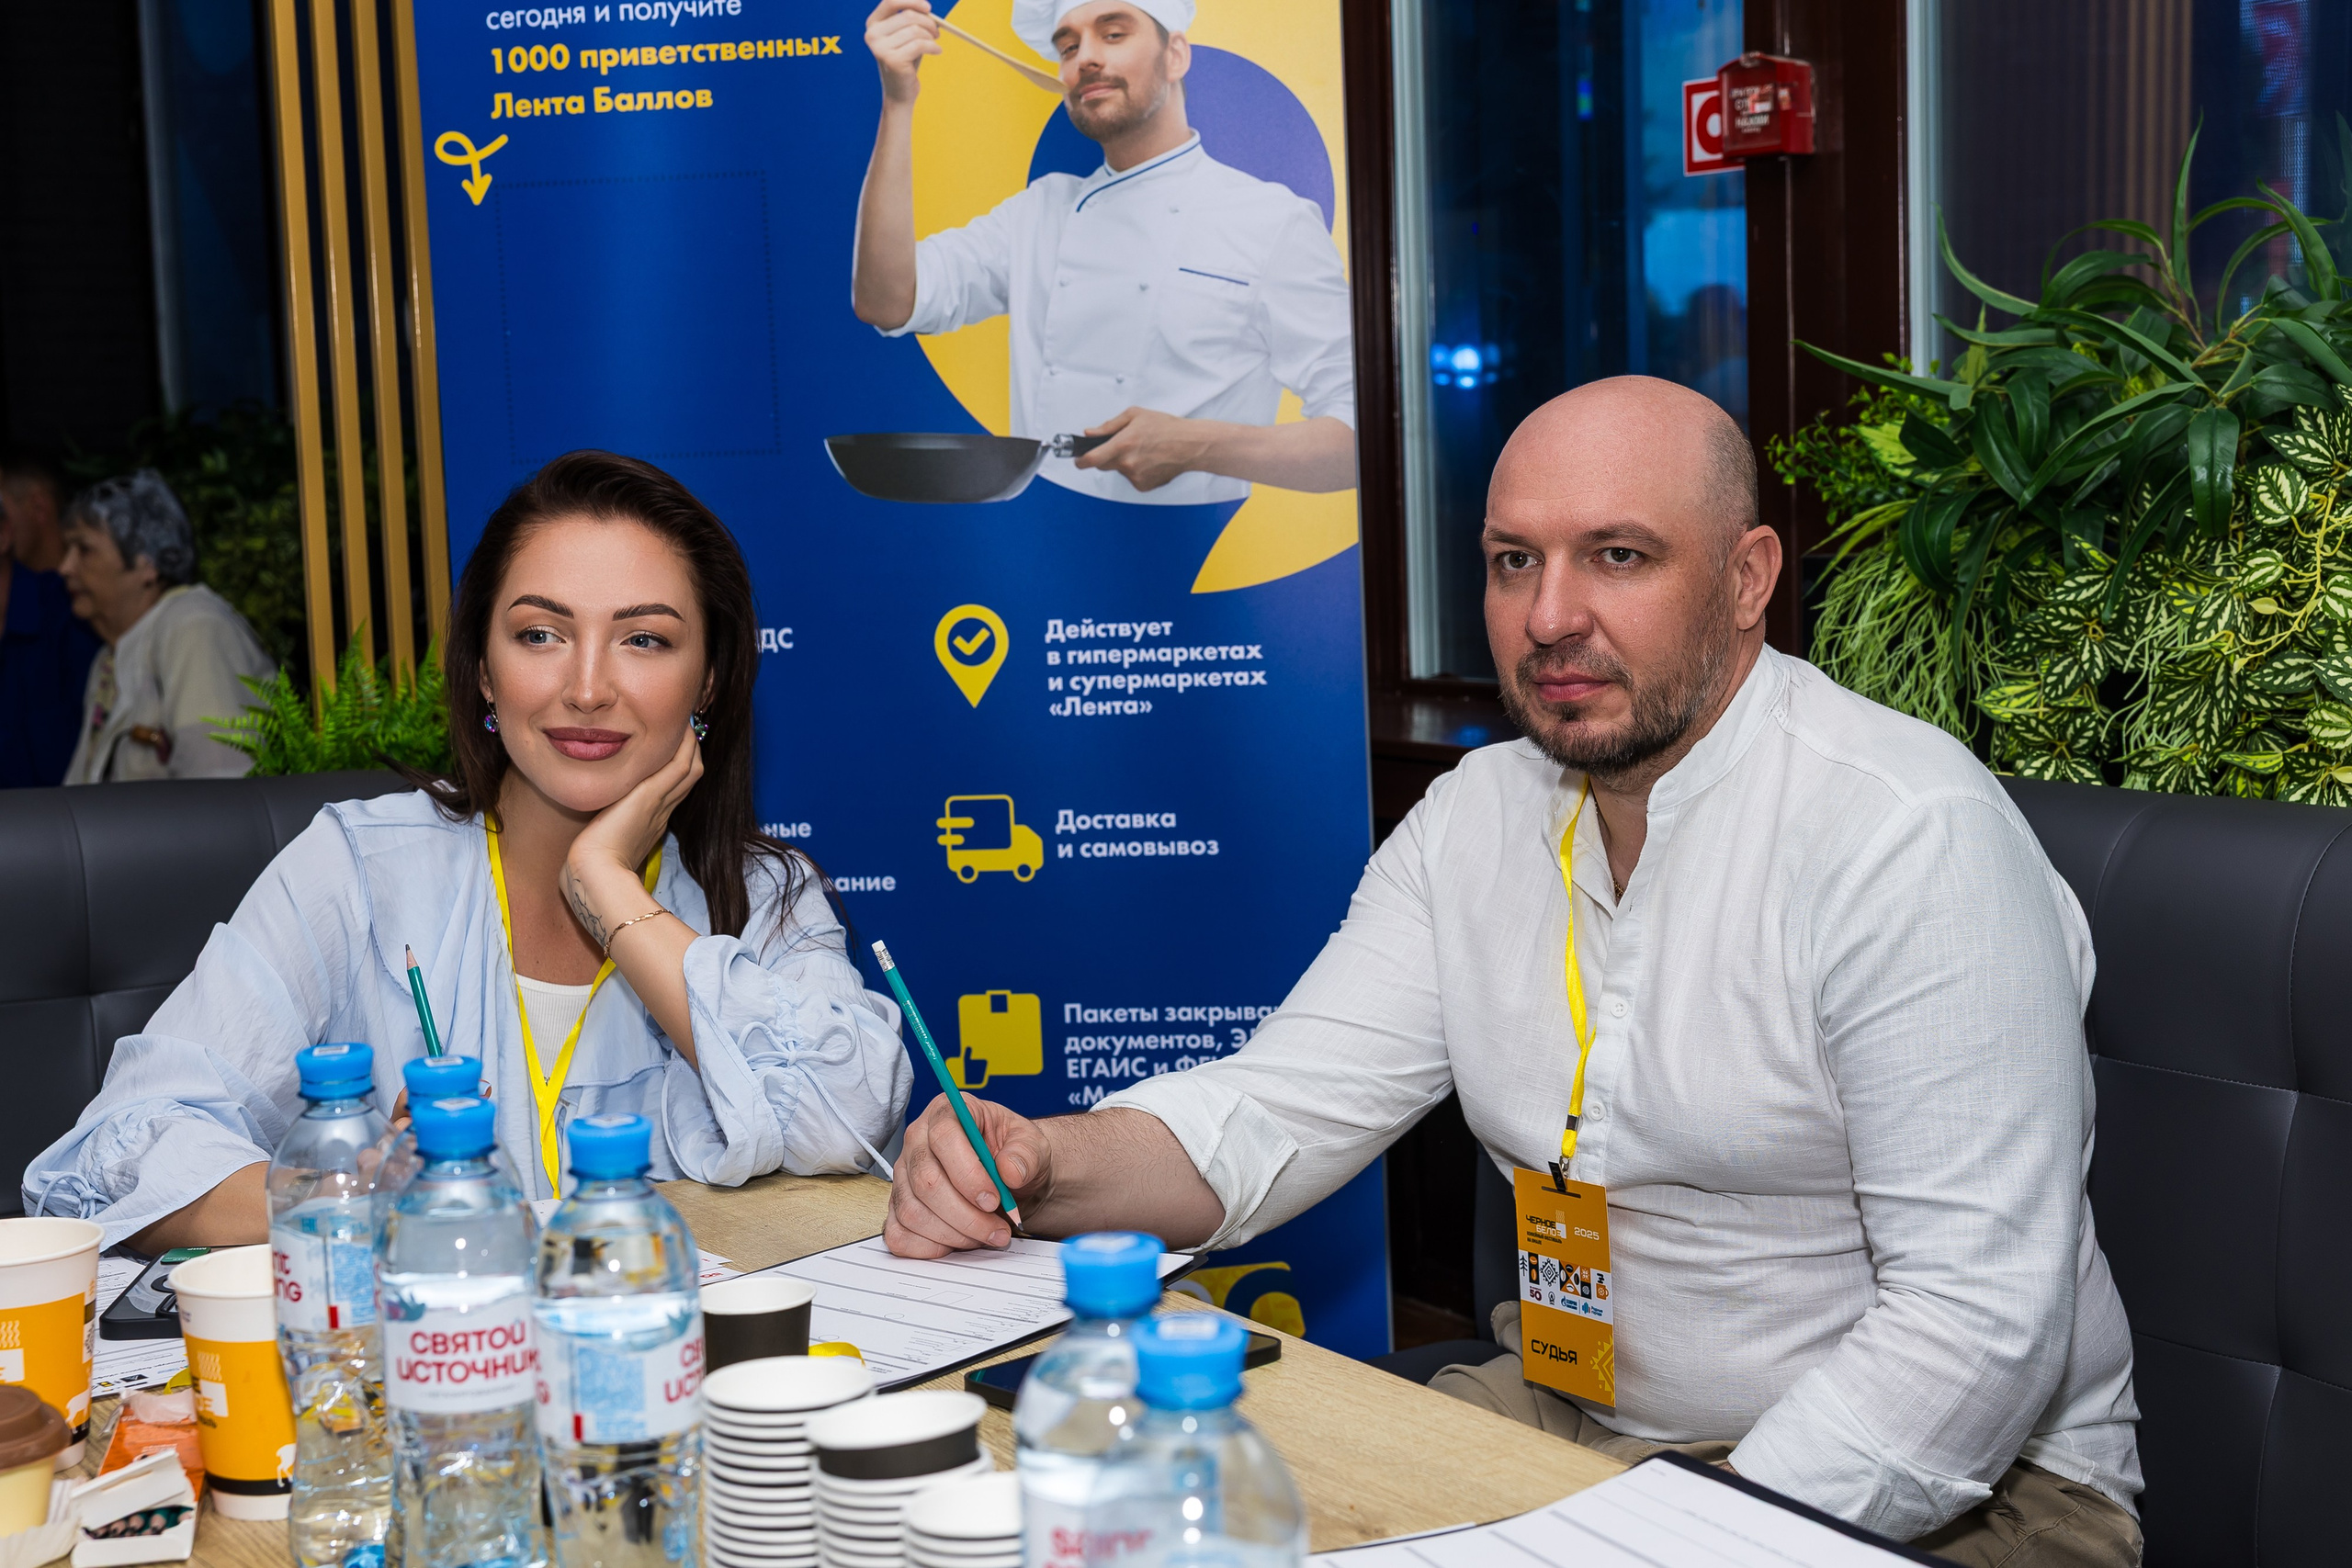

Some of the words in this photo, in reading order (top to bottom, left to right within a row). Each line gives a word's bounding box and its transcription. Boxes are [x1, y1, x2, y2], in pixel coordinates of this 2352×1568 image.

[486, 6, 586, 30] сегодня
[594, 5, 610, 23] и
[619, 0, 742, 28] получите
[492, 43, 571, 73] 1000
[580, 35, 842, 75] приветственных
[491, 92, 585, 119] Лента
[594, 86, 714, 113] Баллов
[755, 626, 794, 653] ДС
[1045, 619, 1173, 643] Действует
[1046, 649, 1062, 666] в
[1067, 644, 1264, 669] гипермаркетах
[1047, 675, 1064, 691] и
[1069, 670, 1268, 696] супермаркетах
[1048, 695, 1153, 717] «Лента»
[759, 822, 812, 838] ные
[1055, 809, 1177, 835] Доставка
[1057, 842, 1073, 858] и
[1080, 839, 1220, 857] самовывоз
[824, 875, 897, 893] ание
[1064, 1003, 1159, 1024] Пакеты
[1164, 1005, 1278, 1028] закрыва
[1064, 1034, 1223, 1056] документов,
[1067, 1055, 1148, 1078] ЕГАИС
[1153, 1062, 1169, 1076] и
[1525, 1214, 1556, 1229] ЧЕРНОЕ
[1574, 1226, 1600, 1241] 2025
[1529, 1288, 1543, 1302] 50
[410, 1316, 526, 1355] СВЯТОЙ
[1532, 1338, 1577, 1365] СУДЬЯ
